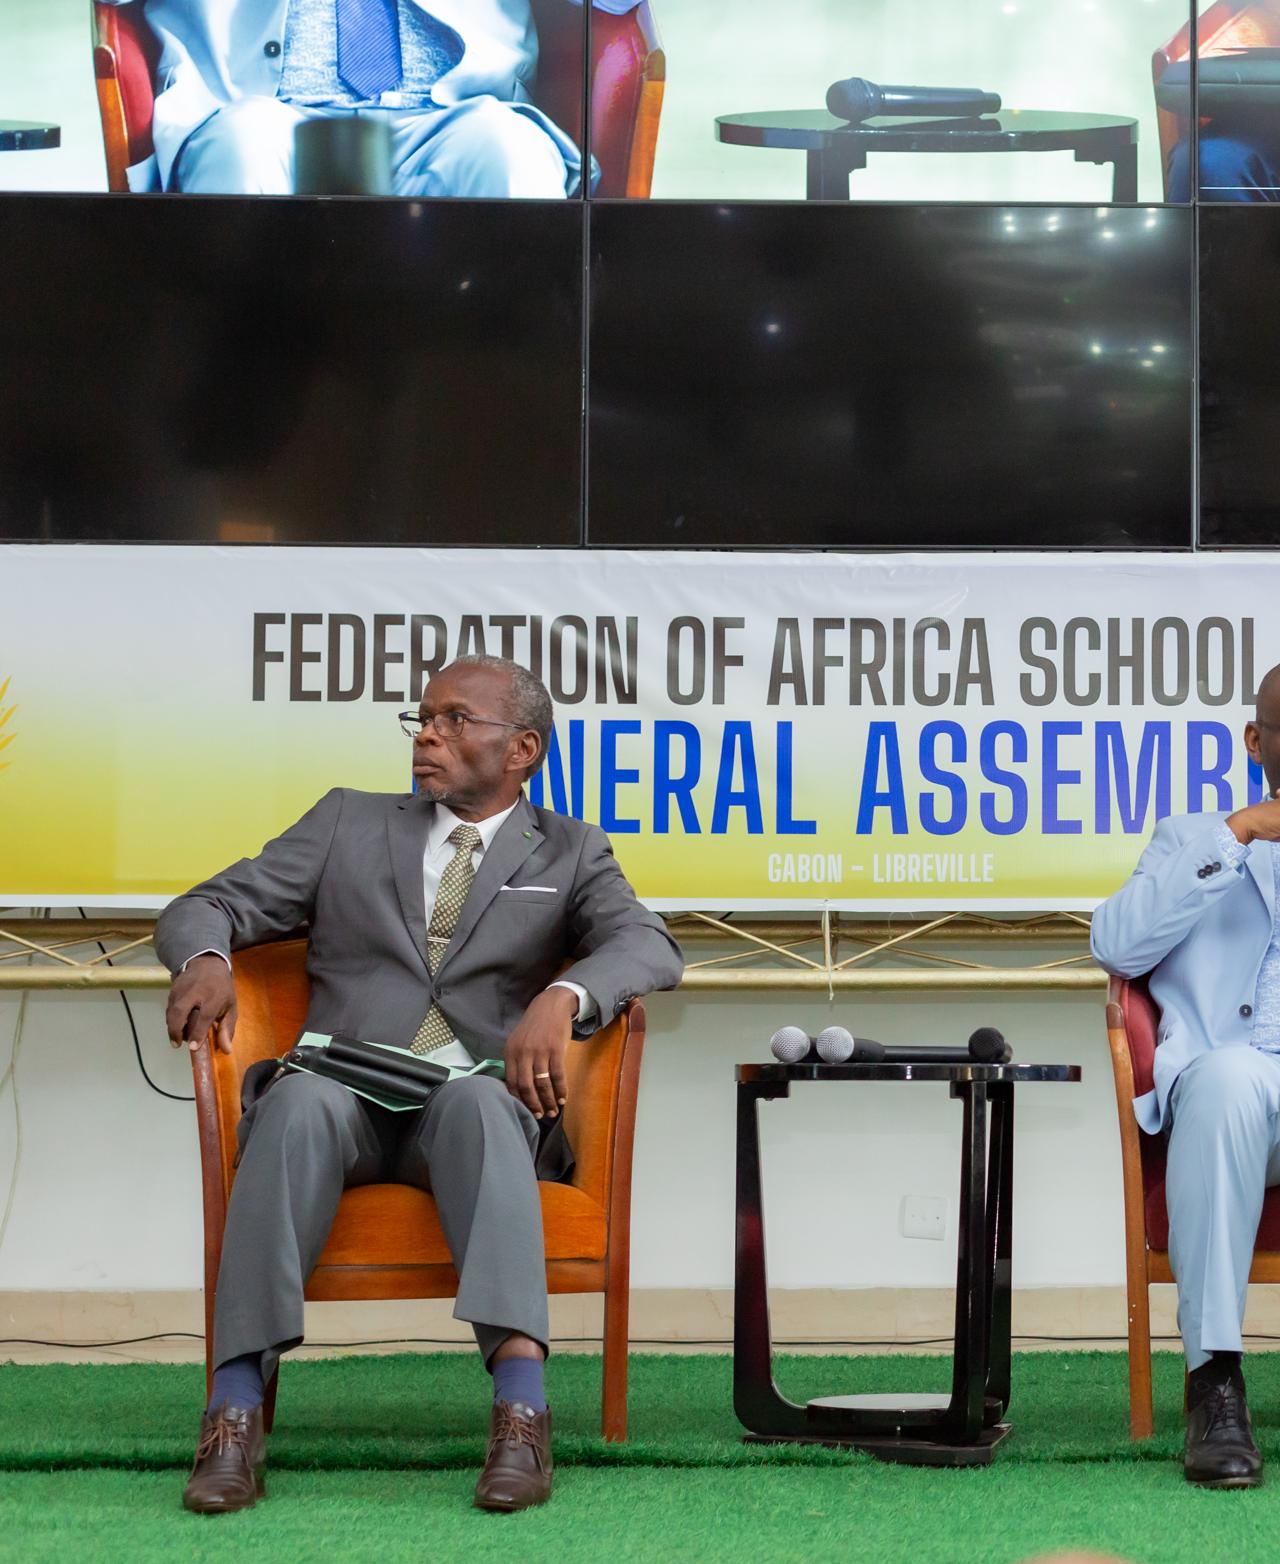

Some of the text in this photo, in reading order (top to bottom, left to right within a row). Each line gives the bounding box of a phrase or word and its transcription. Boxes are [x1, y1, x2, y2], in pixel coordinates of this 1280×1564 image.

[666, 615, 745, 706] OF
[767, 616, 996, 706] AFRICA
[1018, 616, 1258, 706] SCHOOL
[412, 719, 1263, 835] NERAL ASSEMB
[768, 853, 842, 883] GABON
[873, 853, 994, 883] LIBREVILLE
